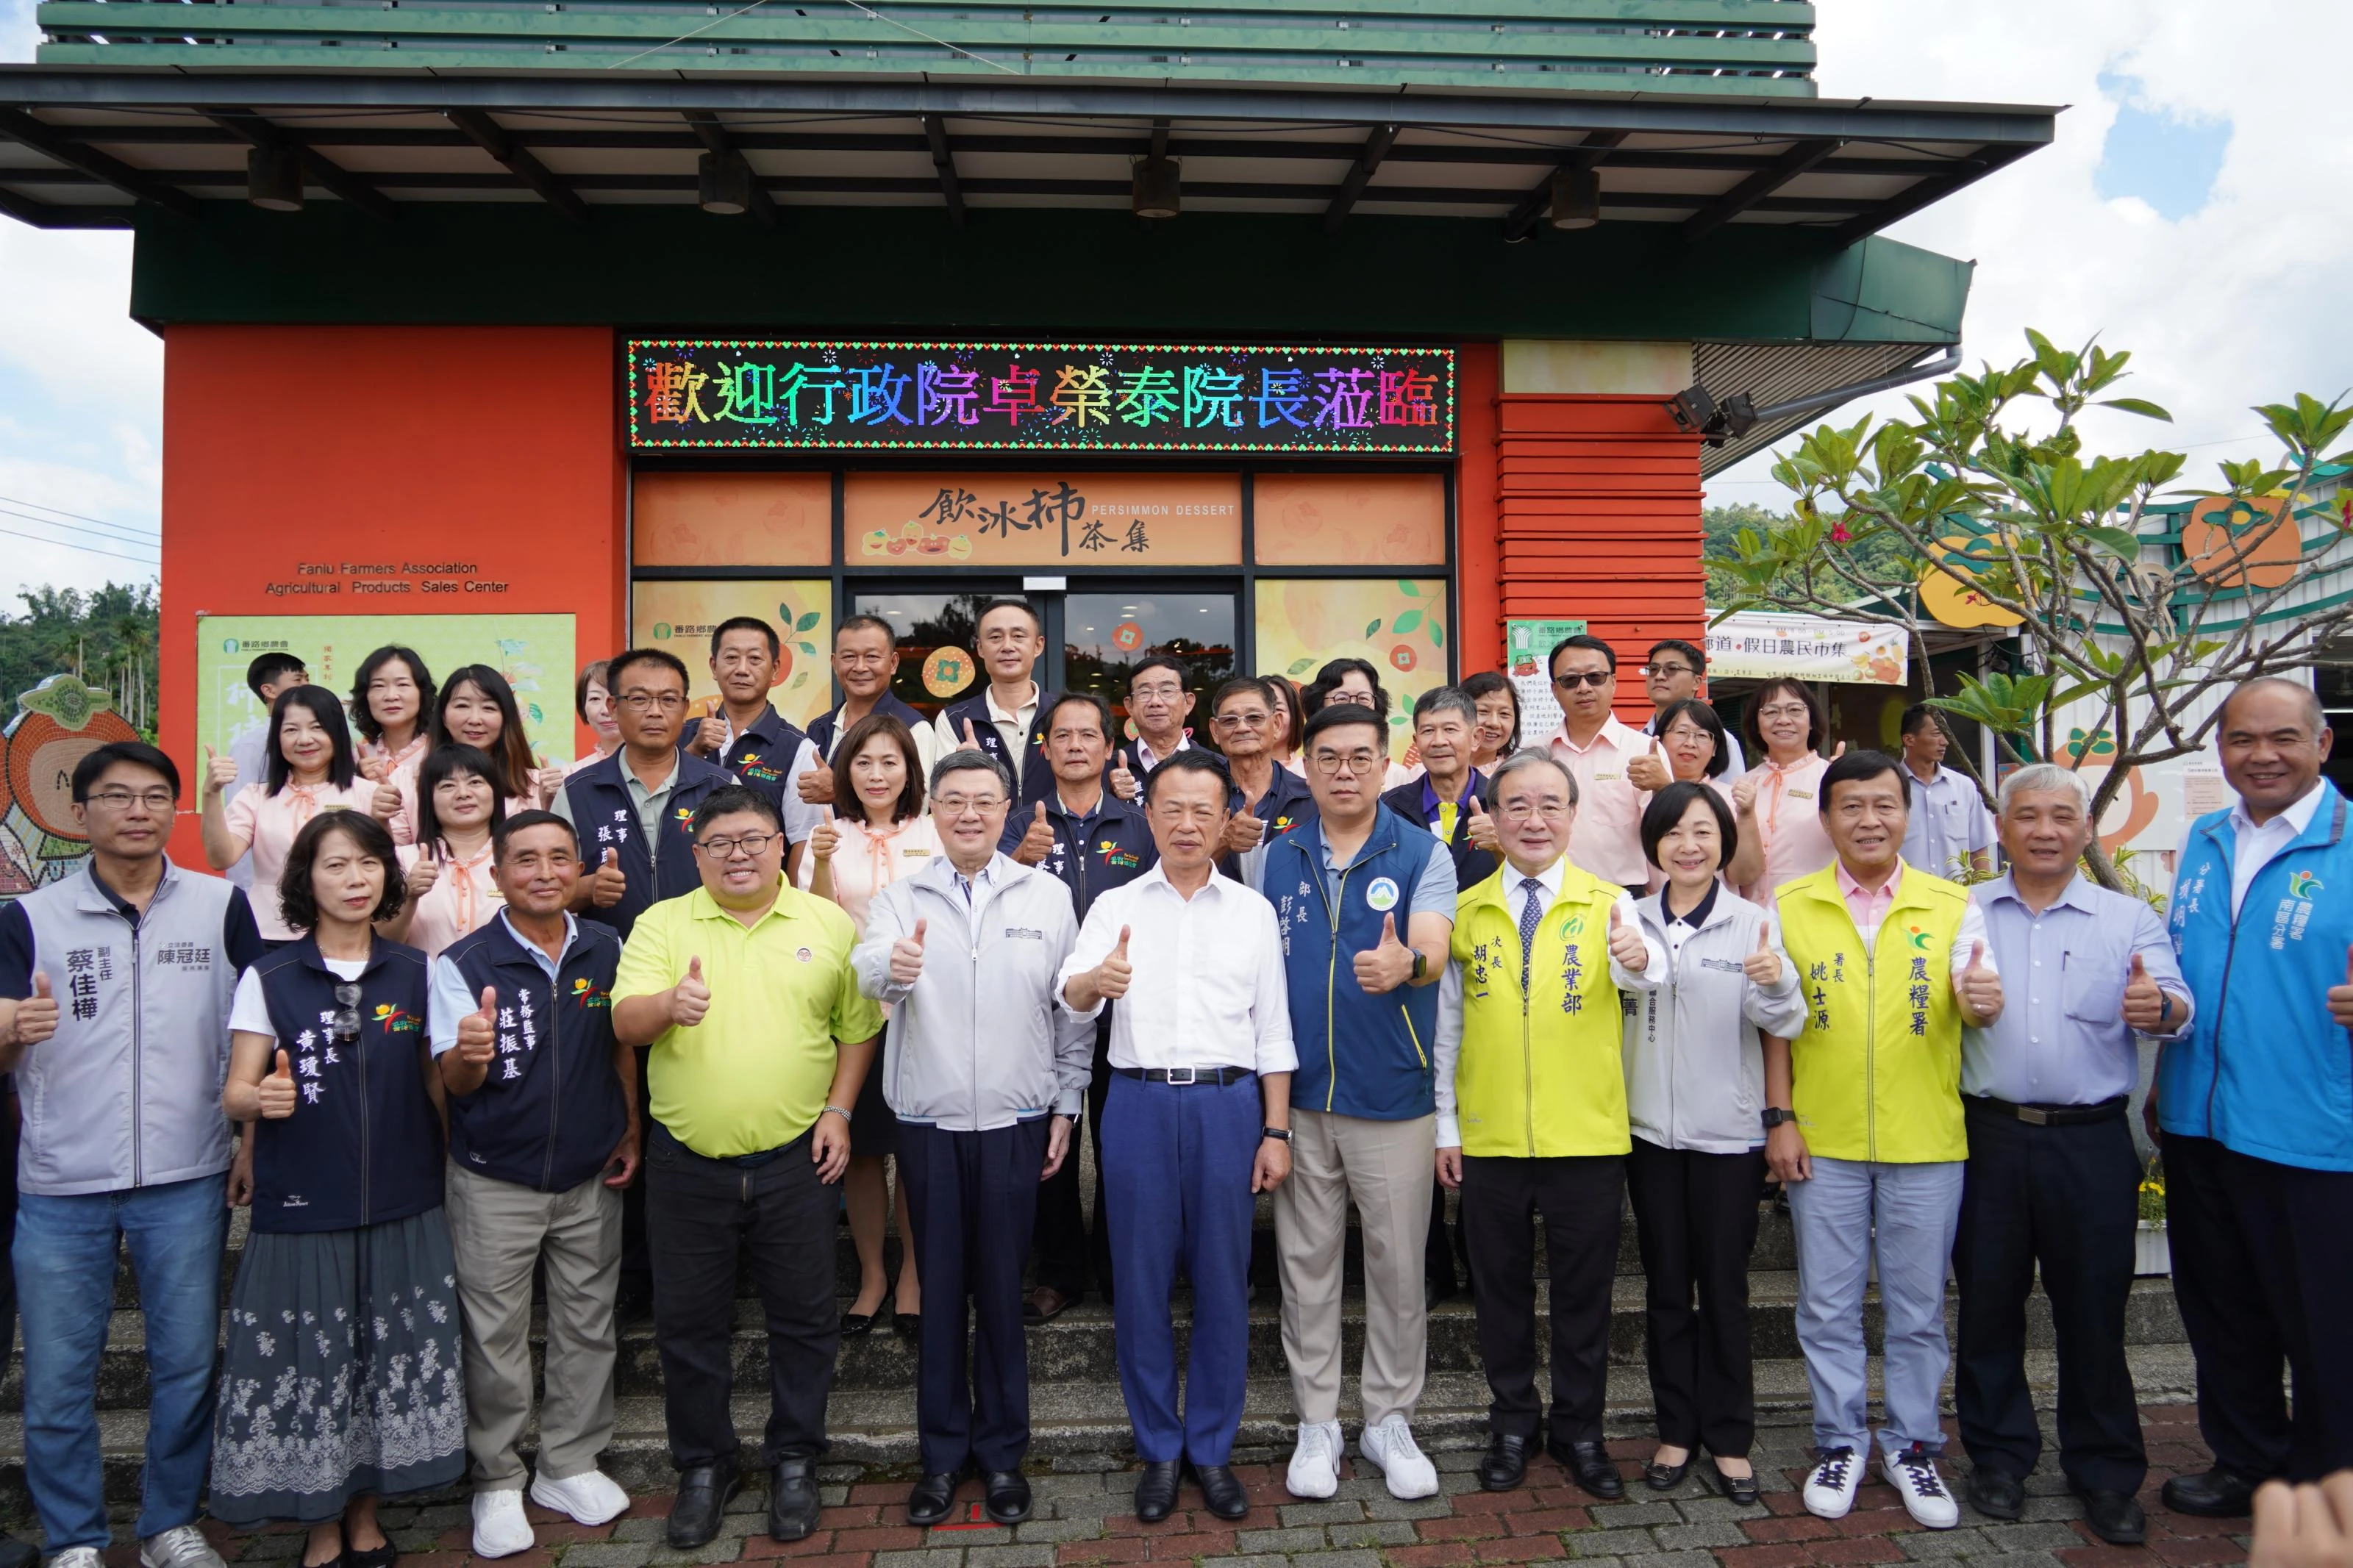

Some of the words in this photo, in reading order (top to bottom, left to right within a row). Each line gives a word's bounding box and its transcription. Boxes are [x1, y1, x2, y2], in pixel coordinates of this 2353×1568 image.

[646, 361, 1438, 429] 歡迎行政院卓榮泰院長蒞臨
[1092, 505, 1168, 516] PERSIMMON
[1176, 504, 1235, 516] DESSERT
[1079, 519, 1150, 553] 茶集
[341, 562, 396, 574] Farmers
[401, 562, 477, 574] Association
[265, 581, 340, 597] Agricultural
[352, 581, 411, 593] Products
[421, 580, 458, 593] Sales
[464, 580, 510, 593] Center
[614, 809, 627, 843] 理事
[1052, 842, 1065, 875] 理事
[1296, 881, 1311, 923] 部長
[97, 946, 113, 981] 副主任
[157, 948, 211, 964] 陳冠廷
[1474, 944, 1489, 998] 胡忠一
[1490, 935, 1503, 969] 次長
[1832, 952, 1845, 983] 署長
[66, 949, 98, 1022] 蔡佳樺
[1561, 944, 1583, 1017] 農業部
[1810, 962, 1830, 1031] 姚士源
[1908, 956, 1932, 1037] 農糧署
[319, 1010, 340, 1065] 理事長
[518, 988, 537, 1050] 常務監事
[499, 1006, 522, 1080] 莊振基
